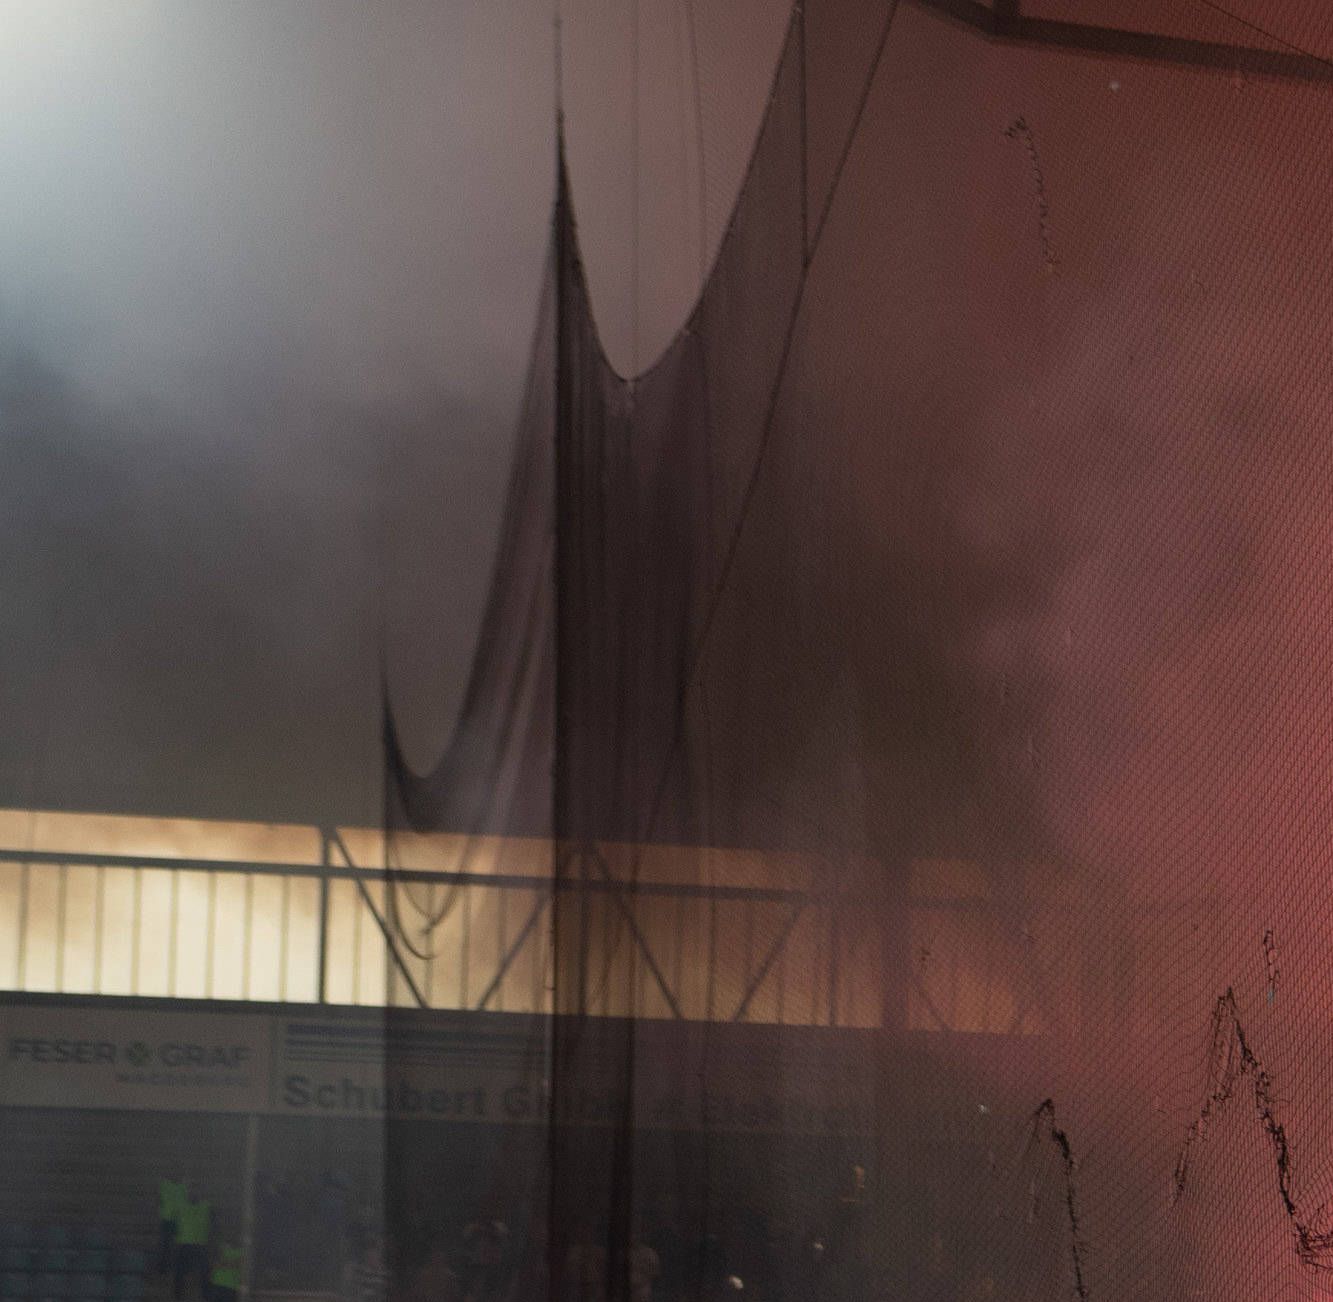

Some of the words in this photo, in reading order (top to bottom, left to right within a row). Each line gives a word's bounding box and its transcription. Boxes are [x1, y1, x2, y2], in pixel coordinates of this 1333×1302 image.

[8, 1038, 117, 1064] FESER
[159, 1042, 252, 1068] GRAF
[282, 1073, 485, 1116] Schubert
